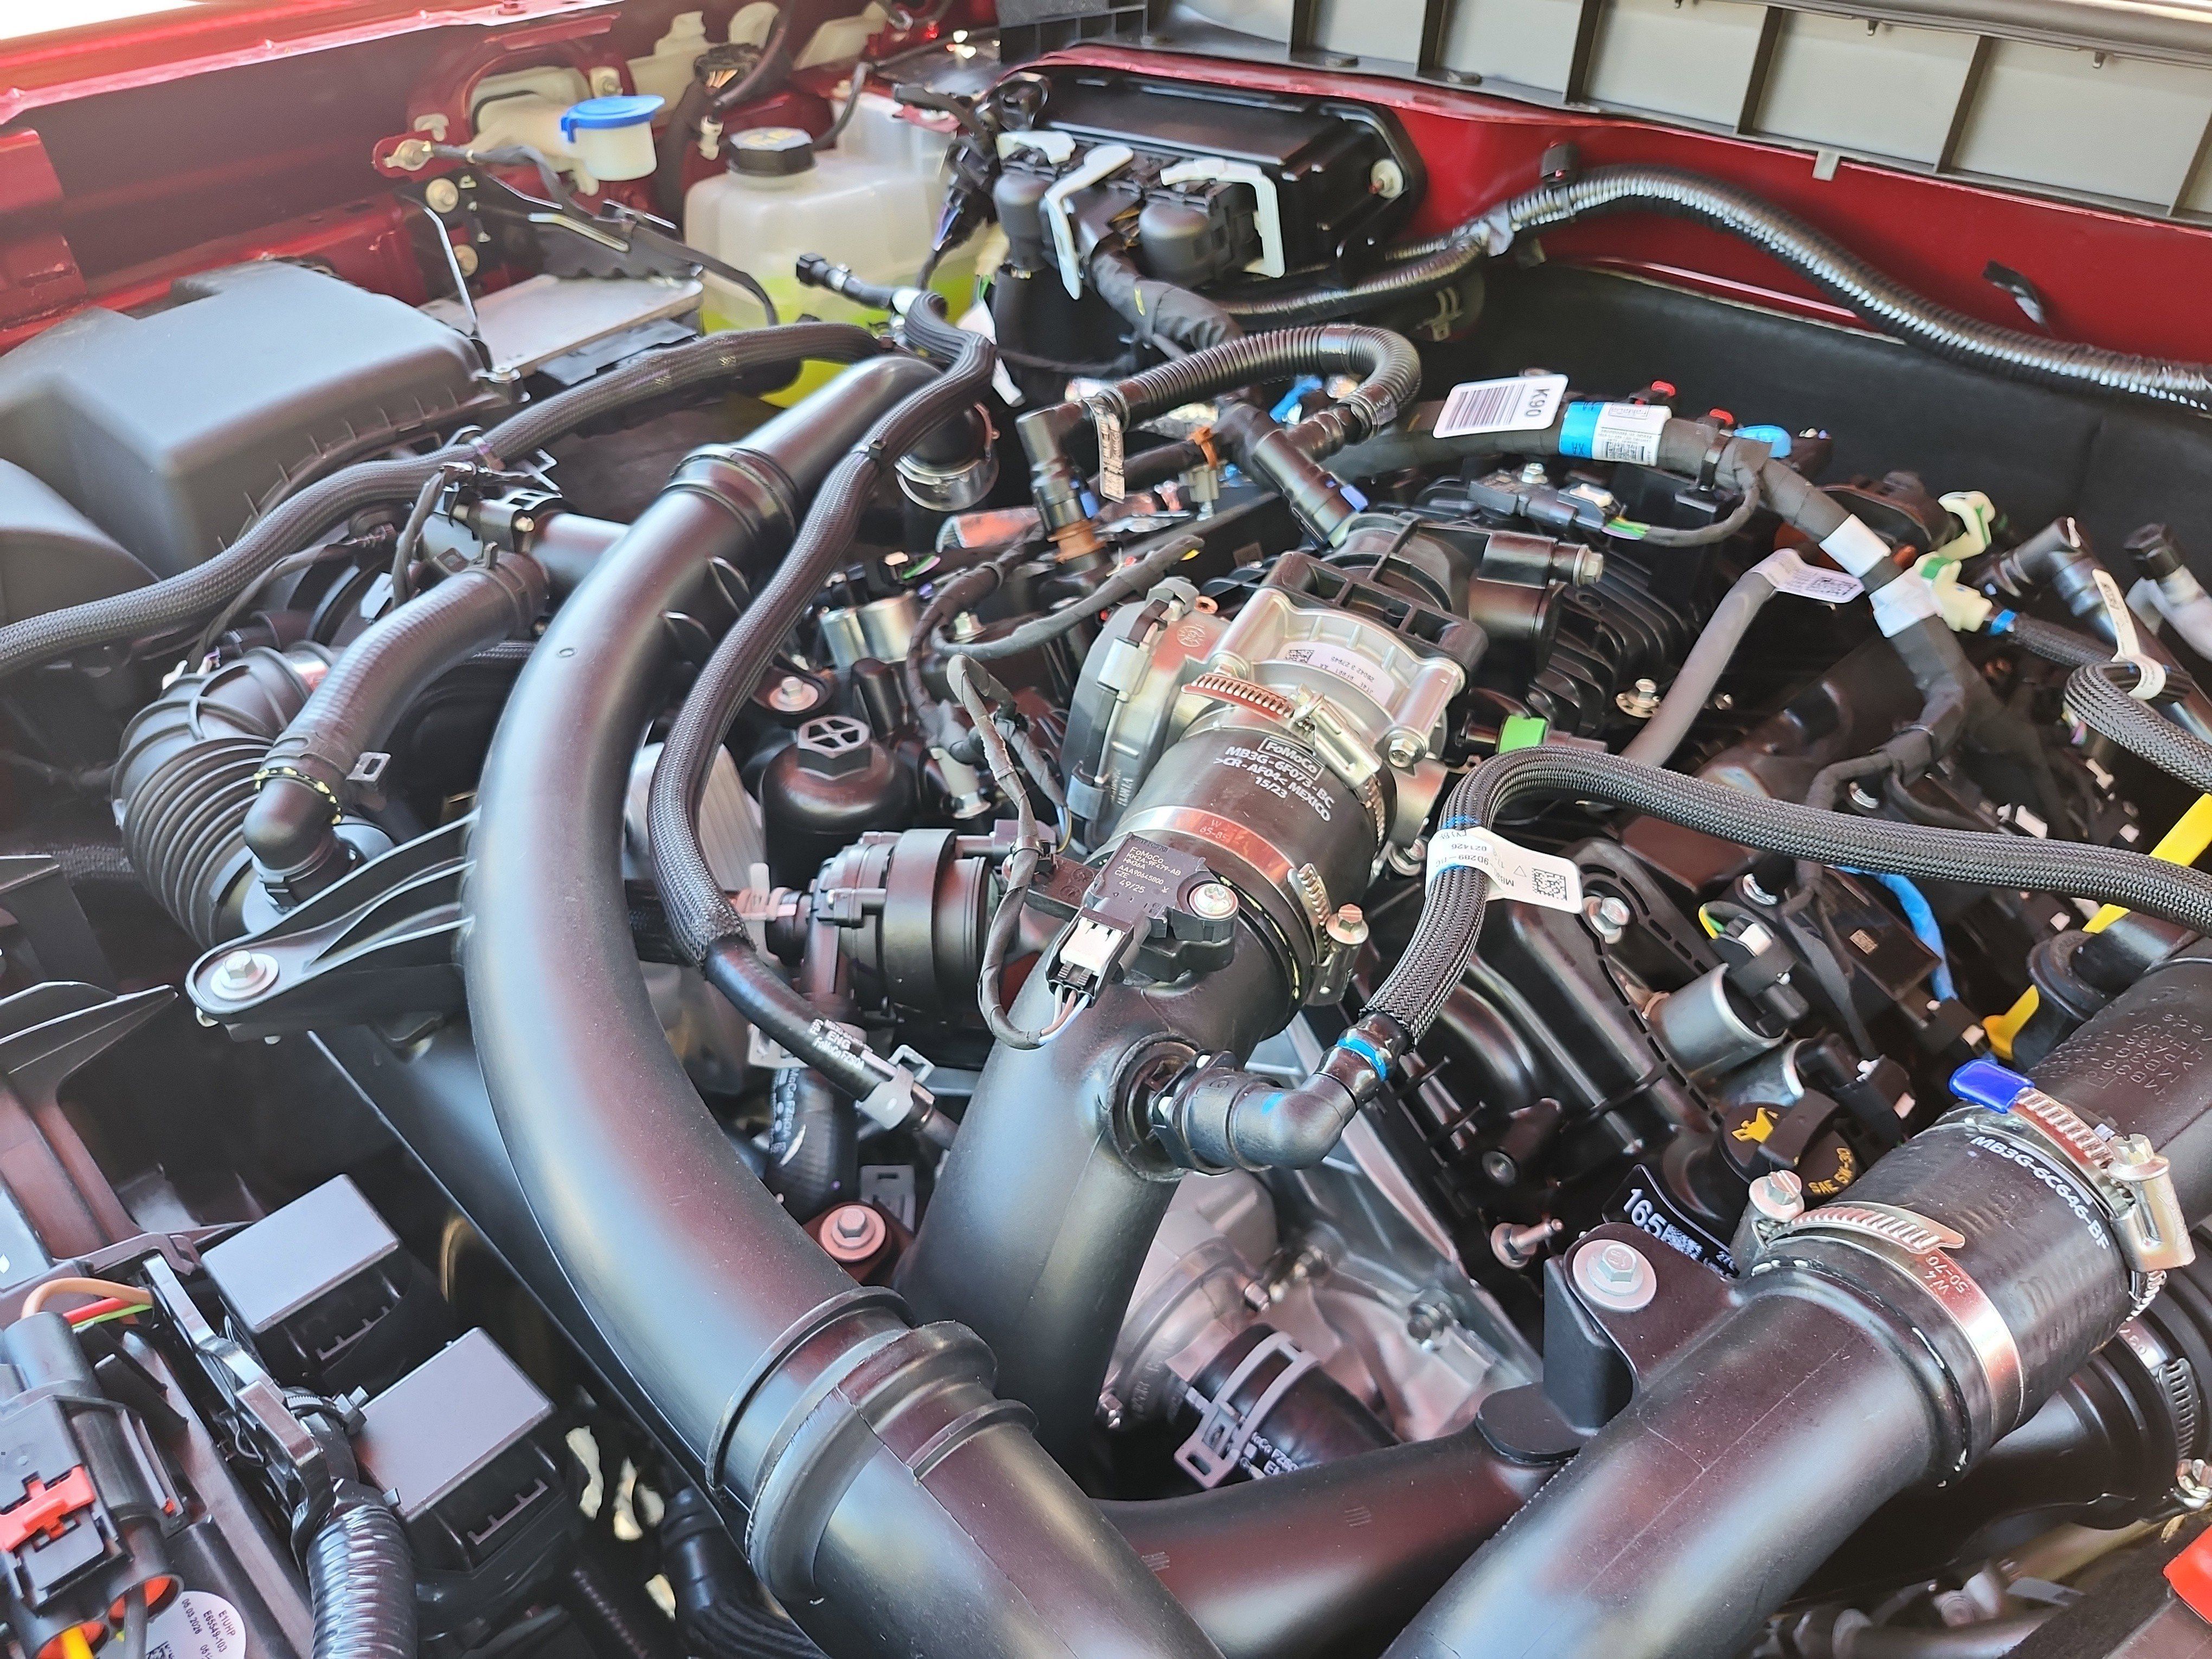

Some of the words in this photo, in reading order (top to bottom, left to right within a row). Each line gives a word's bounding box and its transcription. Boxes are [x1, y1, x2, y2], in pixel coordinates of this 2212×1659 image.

[1526, 388, 1549, 416] K90
[1265, 742, 1316, 774] FoMoCo
[1255, 776, 1288, 799] 15/23
[1288, 782, 1331, 822] MEXICO
[1129, 846, 1164, 864] FoMoCo
[1451, 843, 1487, 852] 021426
[1122, 857, 1146, 870] HM36A
[1114, 869, 1129, 879] CZE
[1119, 879, 1146, 894] 49/25
[1808, 1179, 1840, 1194] SAE
[1926, 1256, 1970, 1294] 50-70
[218, 1610, 236, 1636] E1UHP
